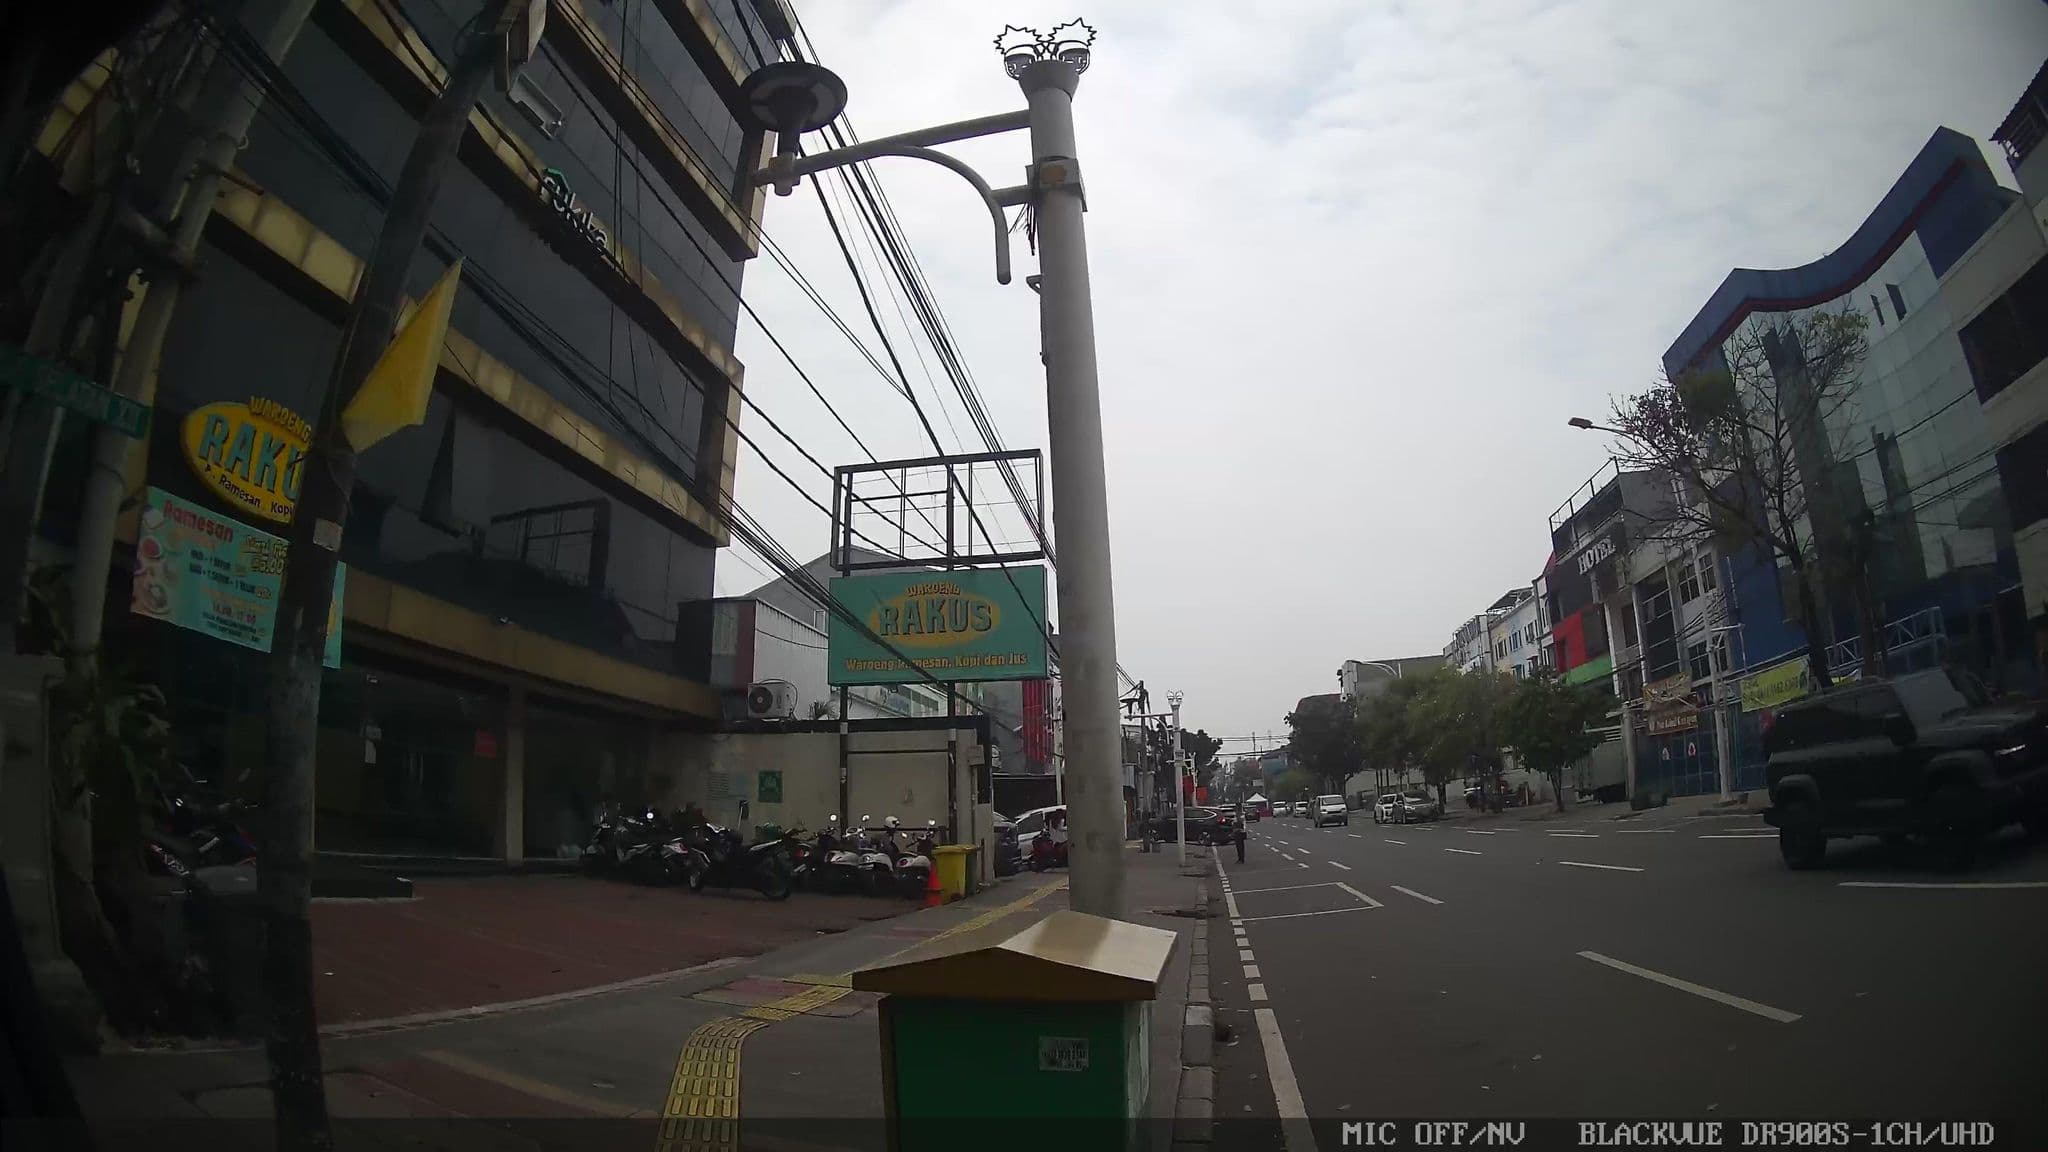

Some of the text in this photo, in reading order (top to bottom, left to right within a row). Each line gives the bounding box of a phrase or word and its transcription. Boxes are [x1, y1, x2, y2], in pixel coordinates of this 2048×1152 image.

[199, 413, 305, 501] RAKU
[218, 474, 261, 508] Ramesan
[905, 582, 960, 597] WAROENG
[880, 598, 992, 636] RAKUS
[846, 658, 896, 672] Waroeng
[984, 653, 1005, 666] dan
[1008, 652, 1027, 665] Jus
